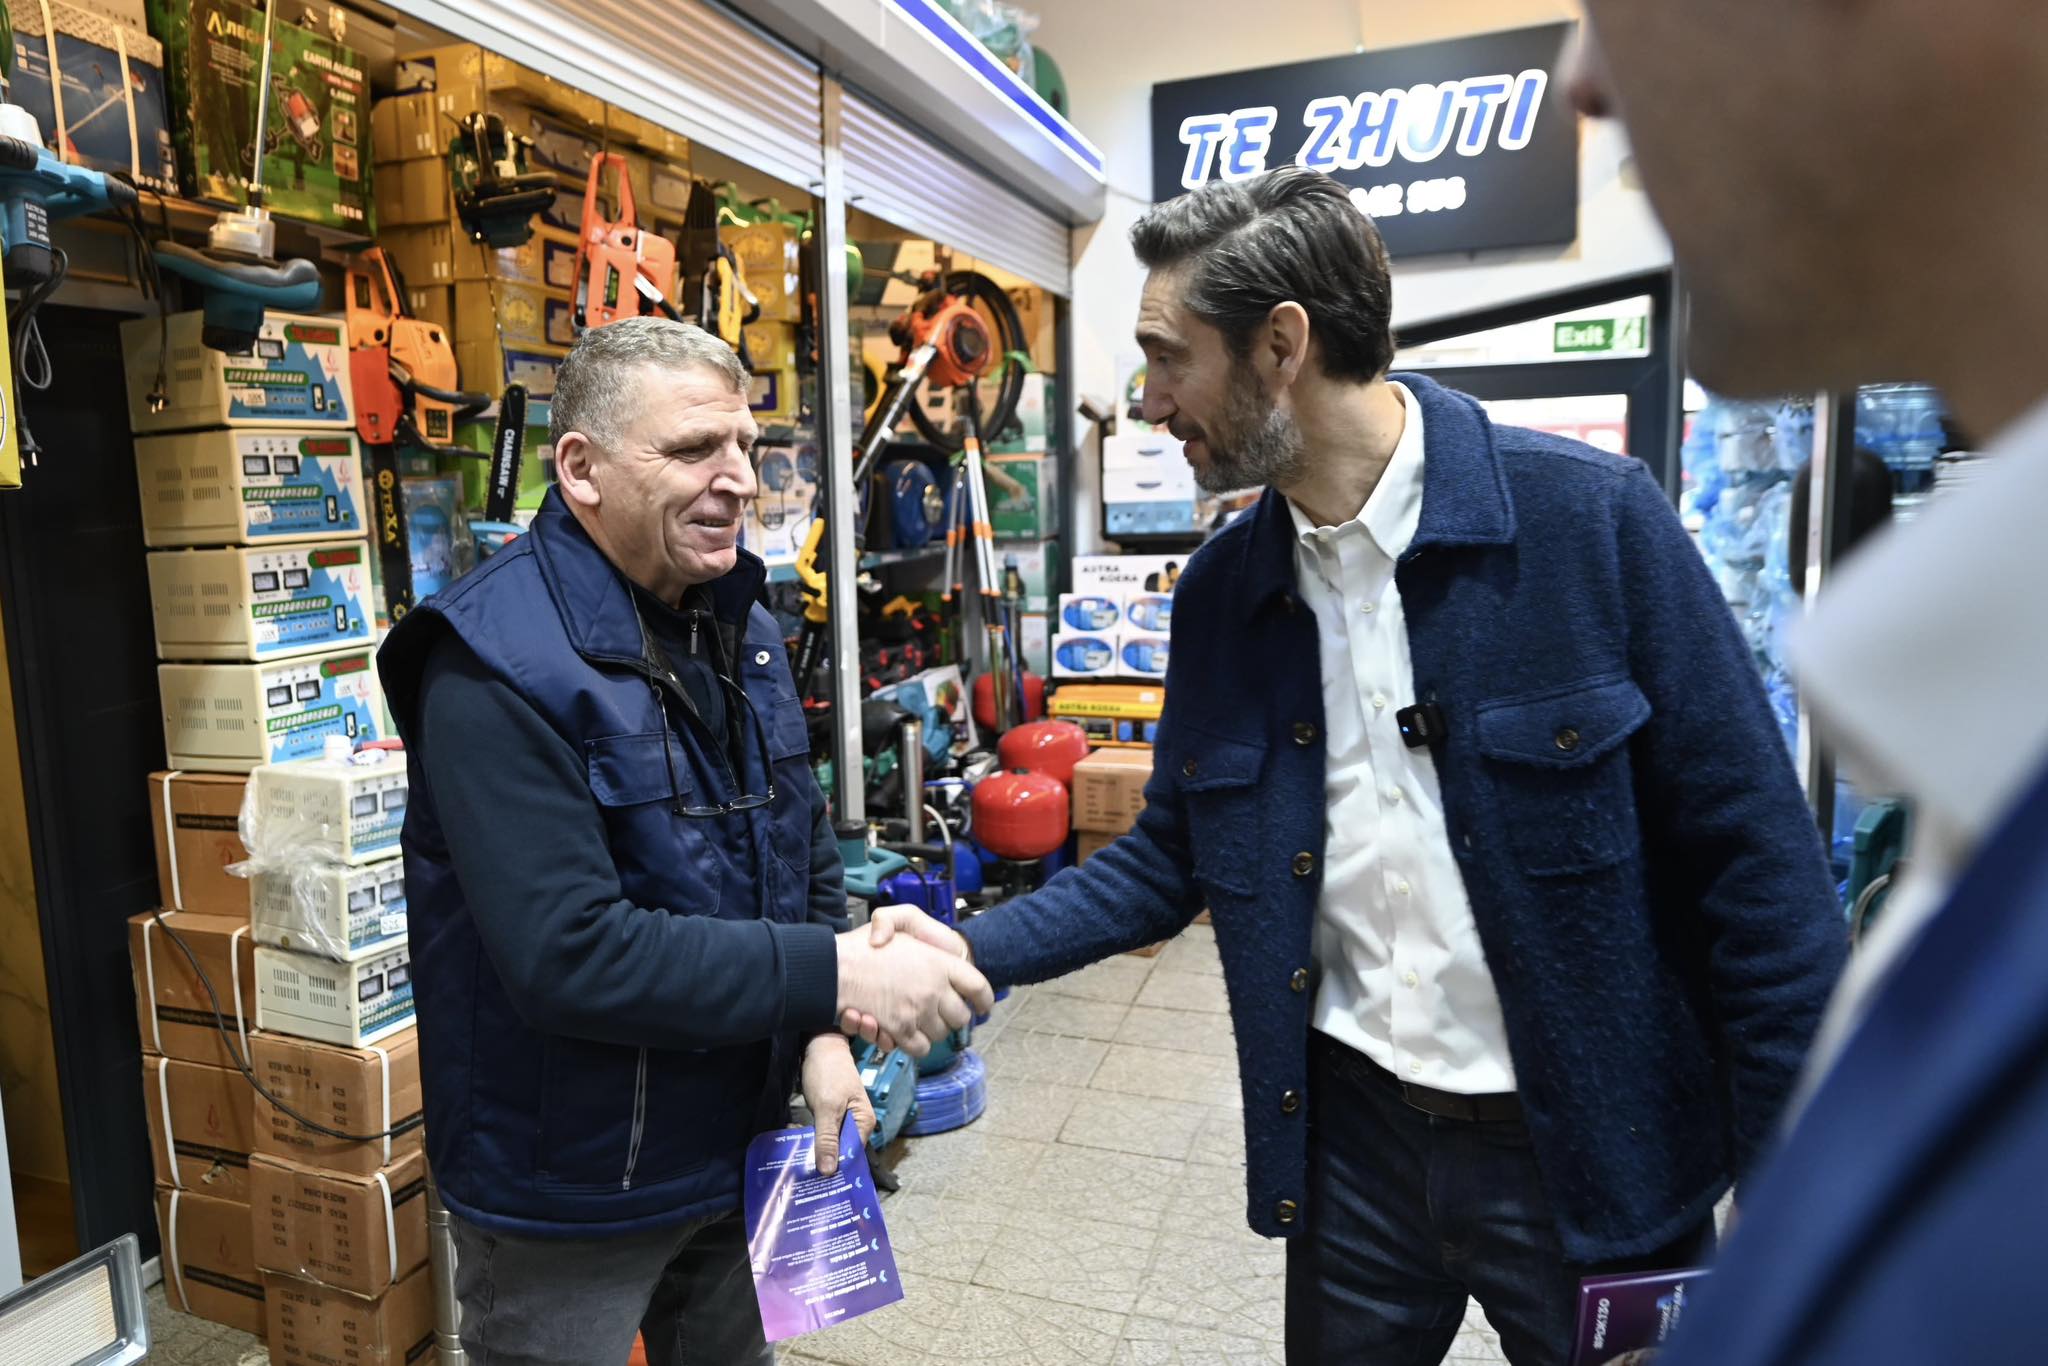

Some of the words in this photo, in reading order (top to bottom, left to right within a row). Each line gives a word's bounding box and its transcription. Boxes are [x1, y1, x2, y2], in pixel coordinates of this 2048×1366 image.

[1179, 106, 1278, 190] TE
[1295, 69, 1548, 175] ZHUTI
[1557, 324, 1606, 348] Exit
[498, 428, 516, 492] CHAINSAW
